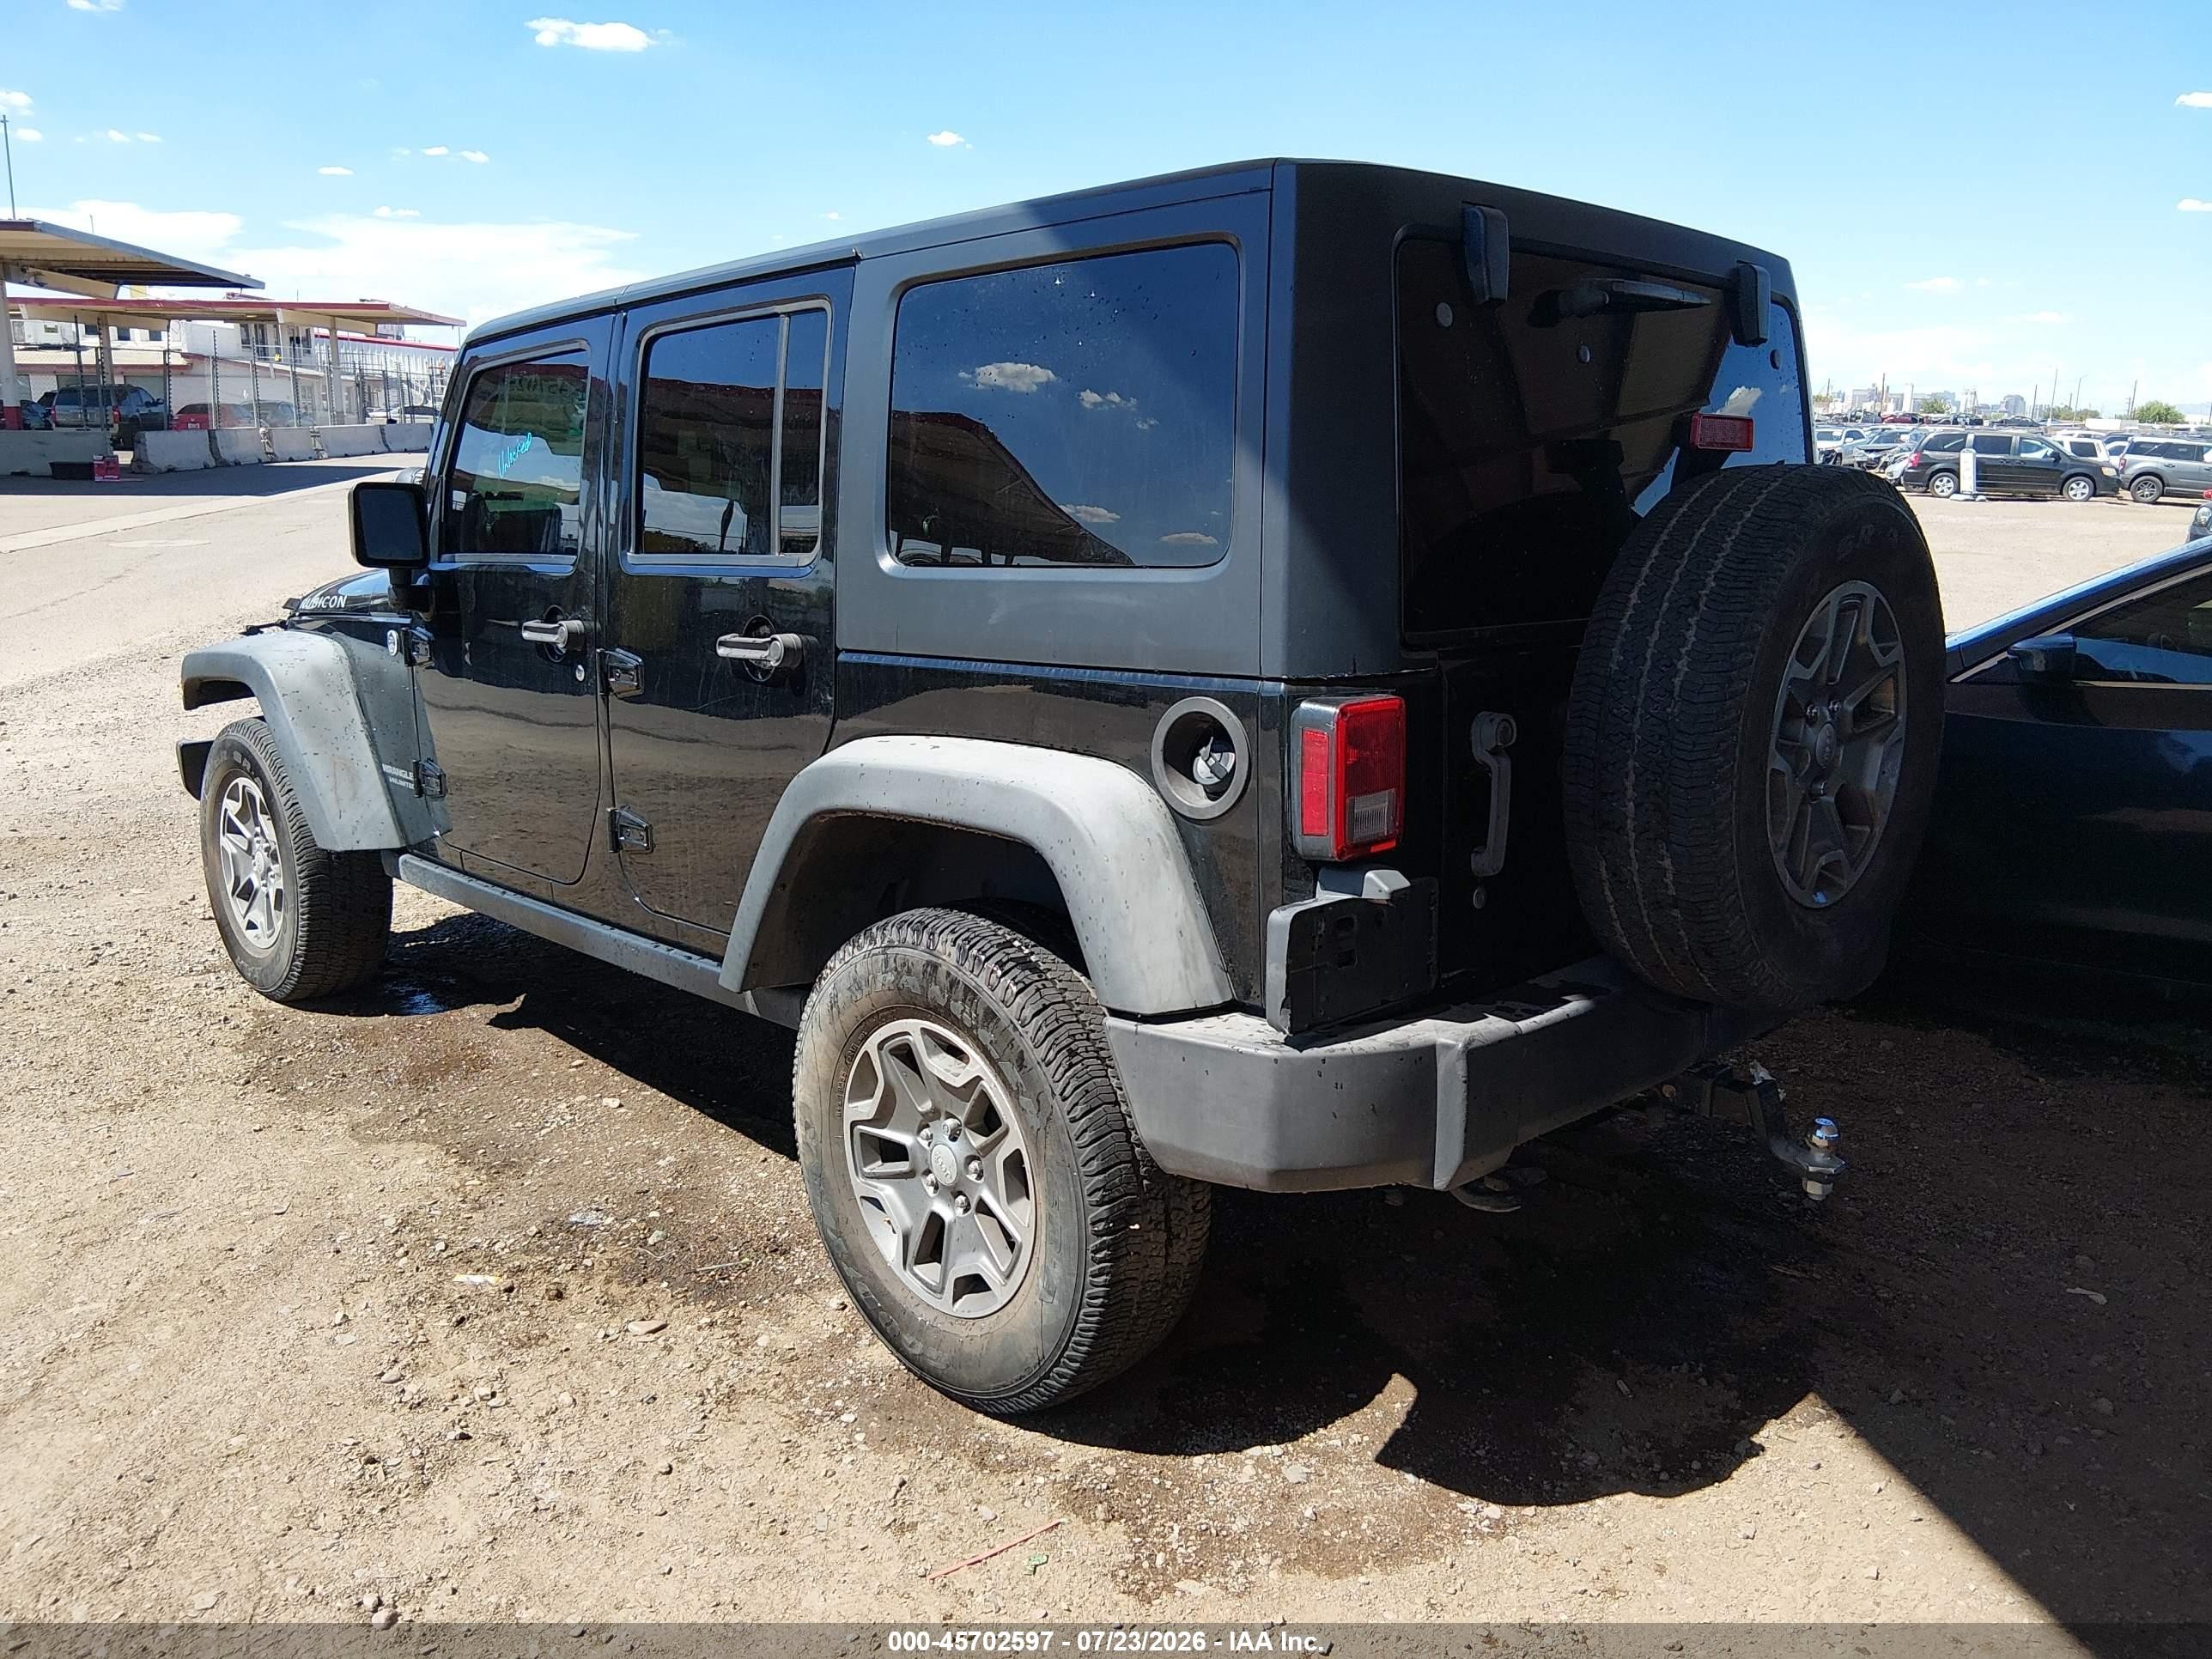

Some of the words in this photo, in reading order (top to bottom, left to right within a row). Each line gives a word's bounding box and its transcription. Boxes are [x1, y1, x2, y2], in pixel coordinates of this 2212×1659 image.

[300, 593, 348, 610] RUBICON
[381, 763, 414, 781] WRANGLE
[388, 776, 414, 790] UNLIMITE
